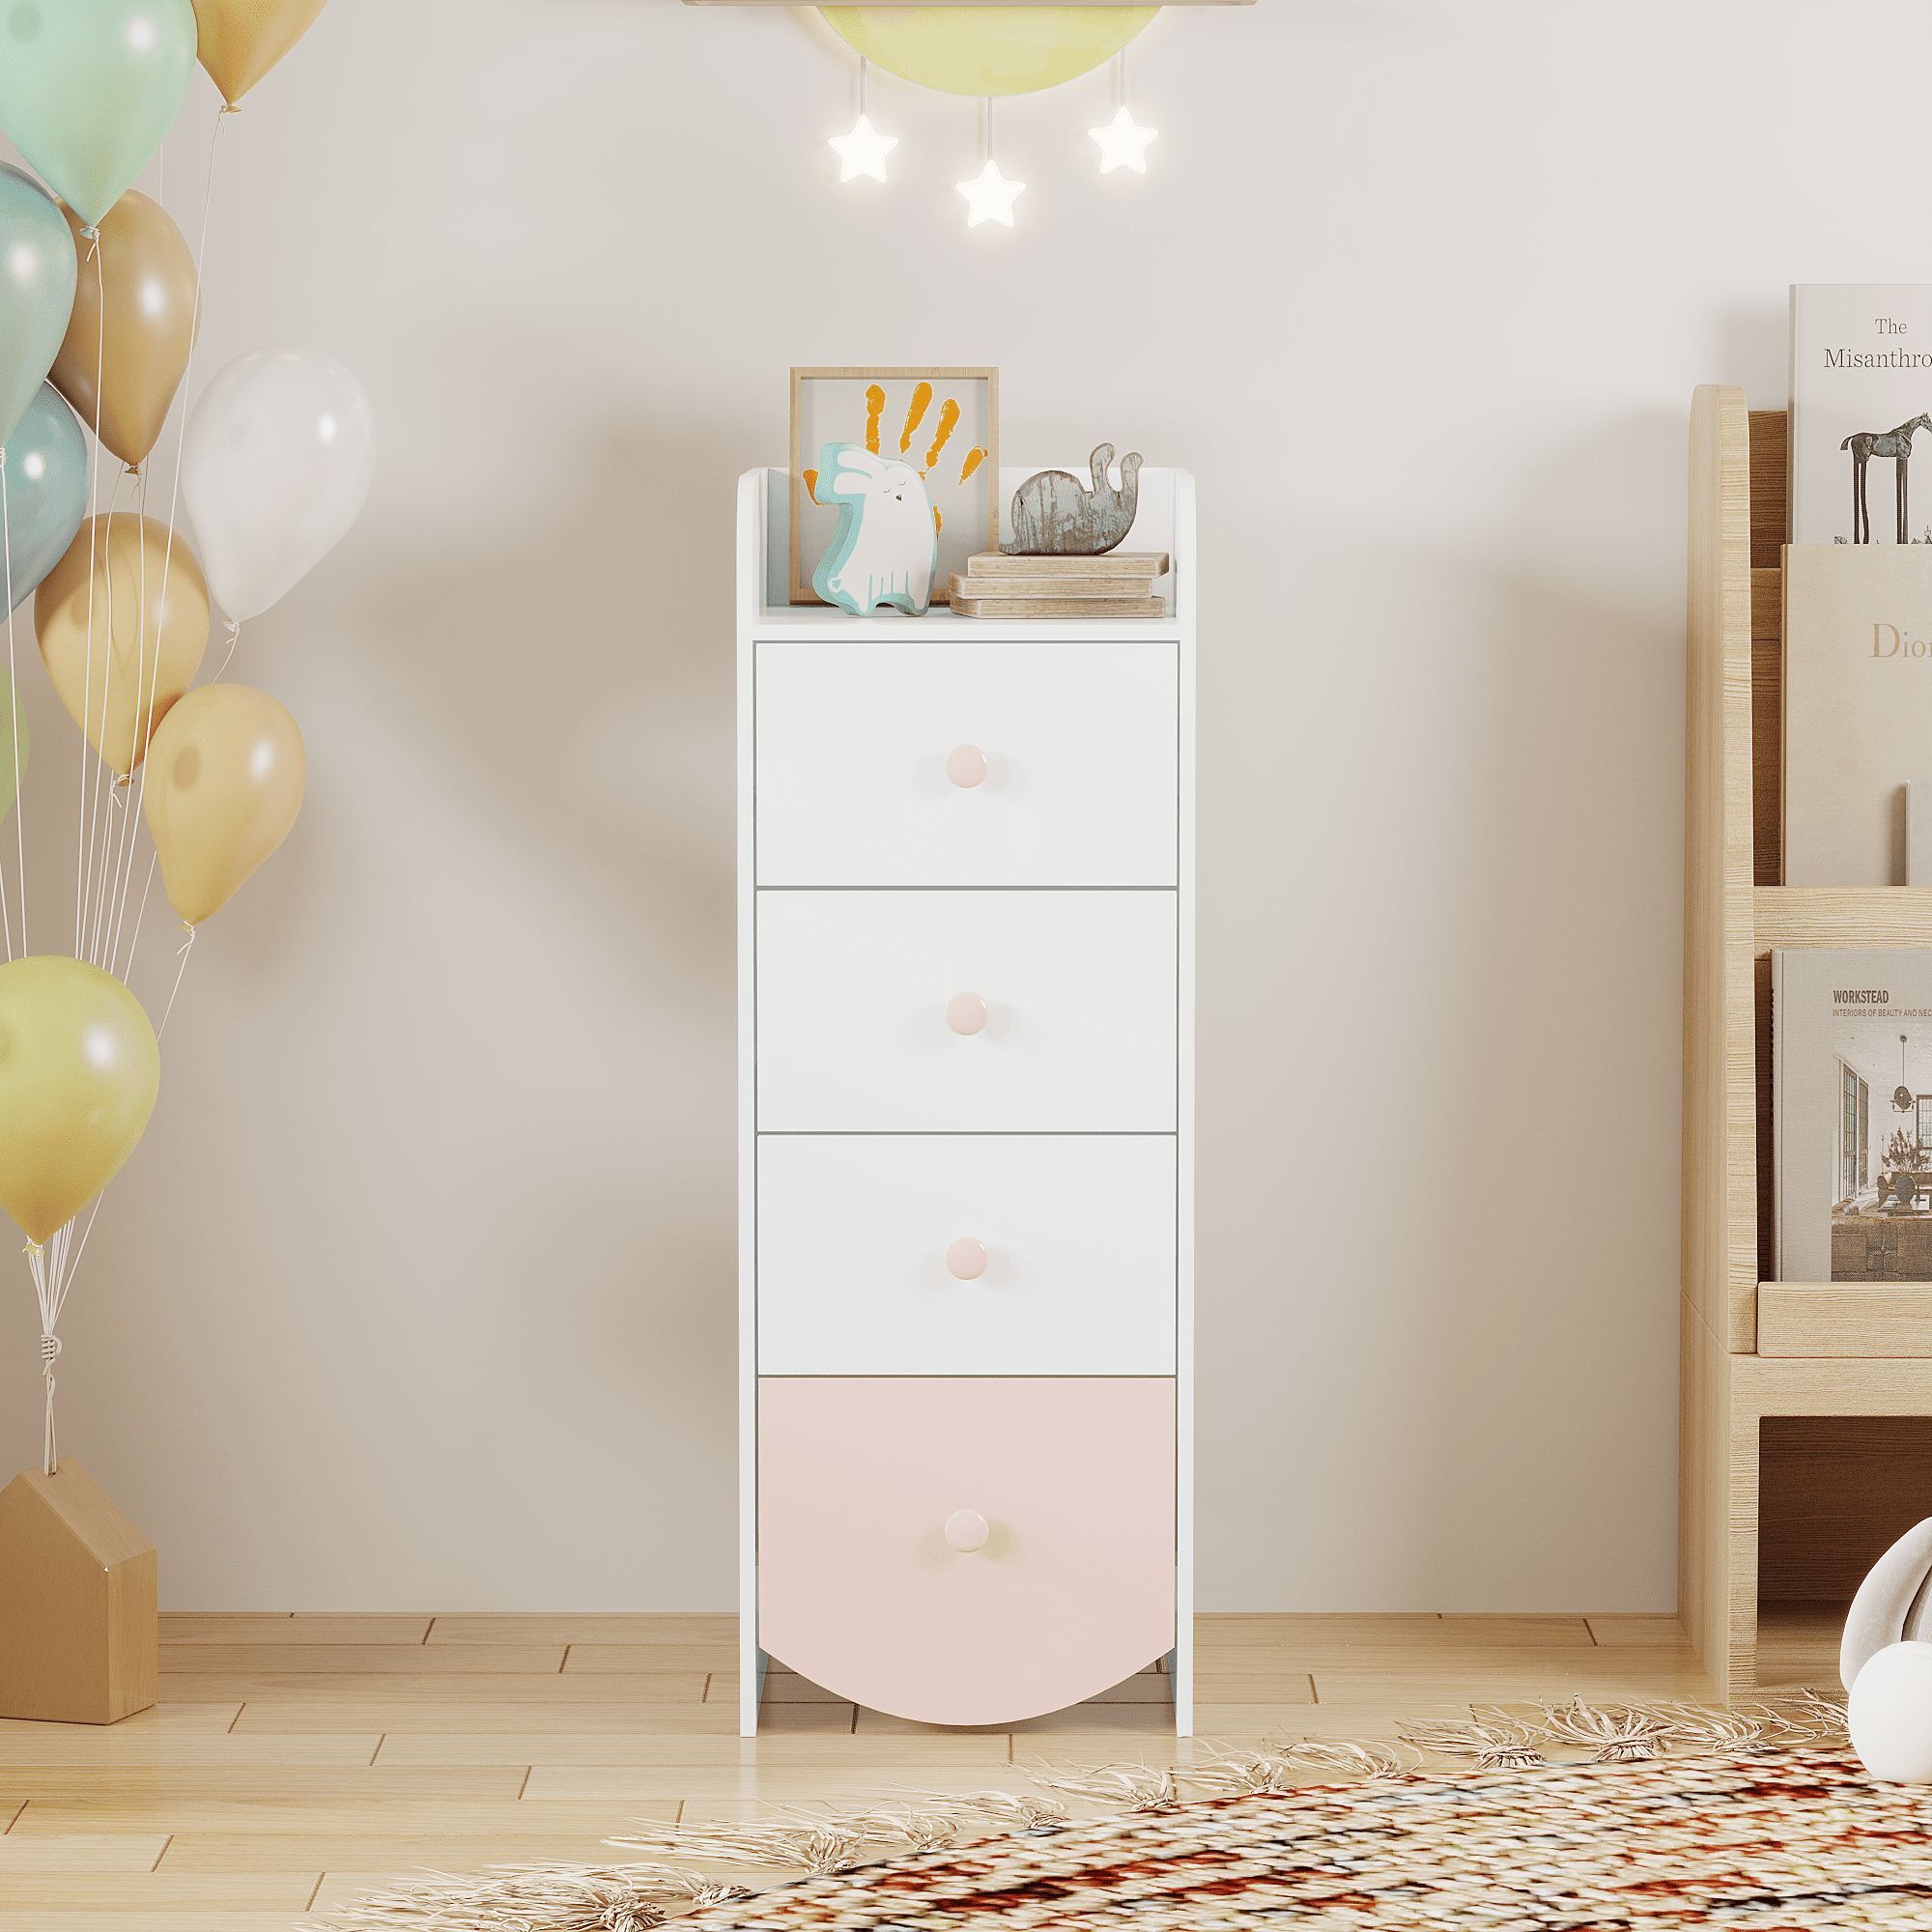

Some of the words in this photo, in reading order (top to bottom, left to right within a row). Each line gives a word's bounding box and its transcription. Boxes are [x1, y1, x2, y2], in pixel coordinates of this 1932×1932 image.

[1875, 318, 1908, 334] The
[1824, 348, 1932, 368] Misanthro
[1833, 990, 1889, 1004] WORKSTEAD
[1833, 1009, 1867, 1017] INTERIORS
[1868, 1009, 1877, 1017] OF
[1878, 1009, 1902, 1017] BEAUTY
[1904, 1009, 1918, 1017] AND
